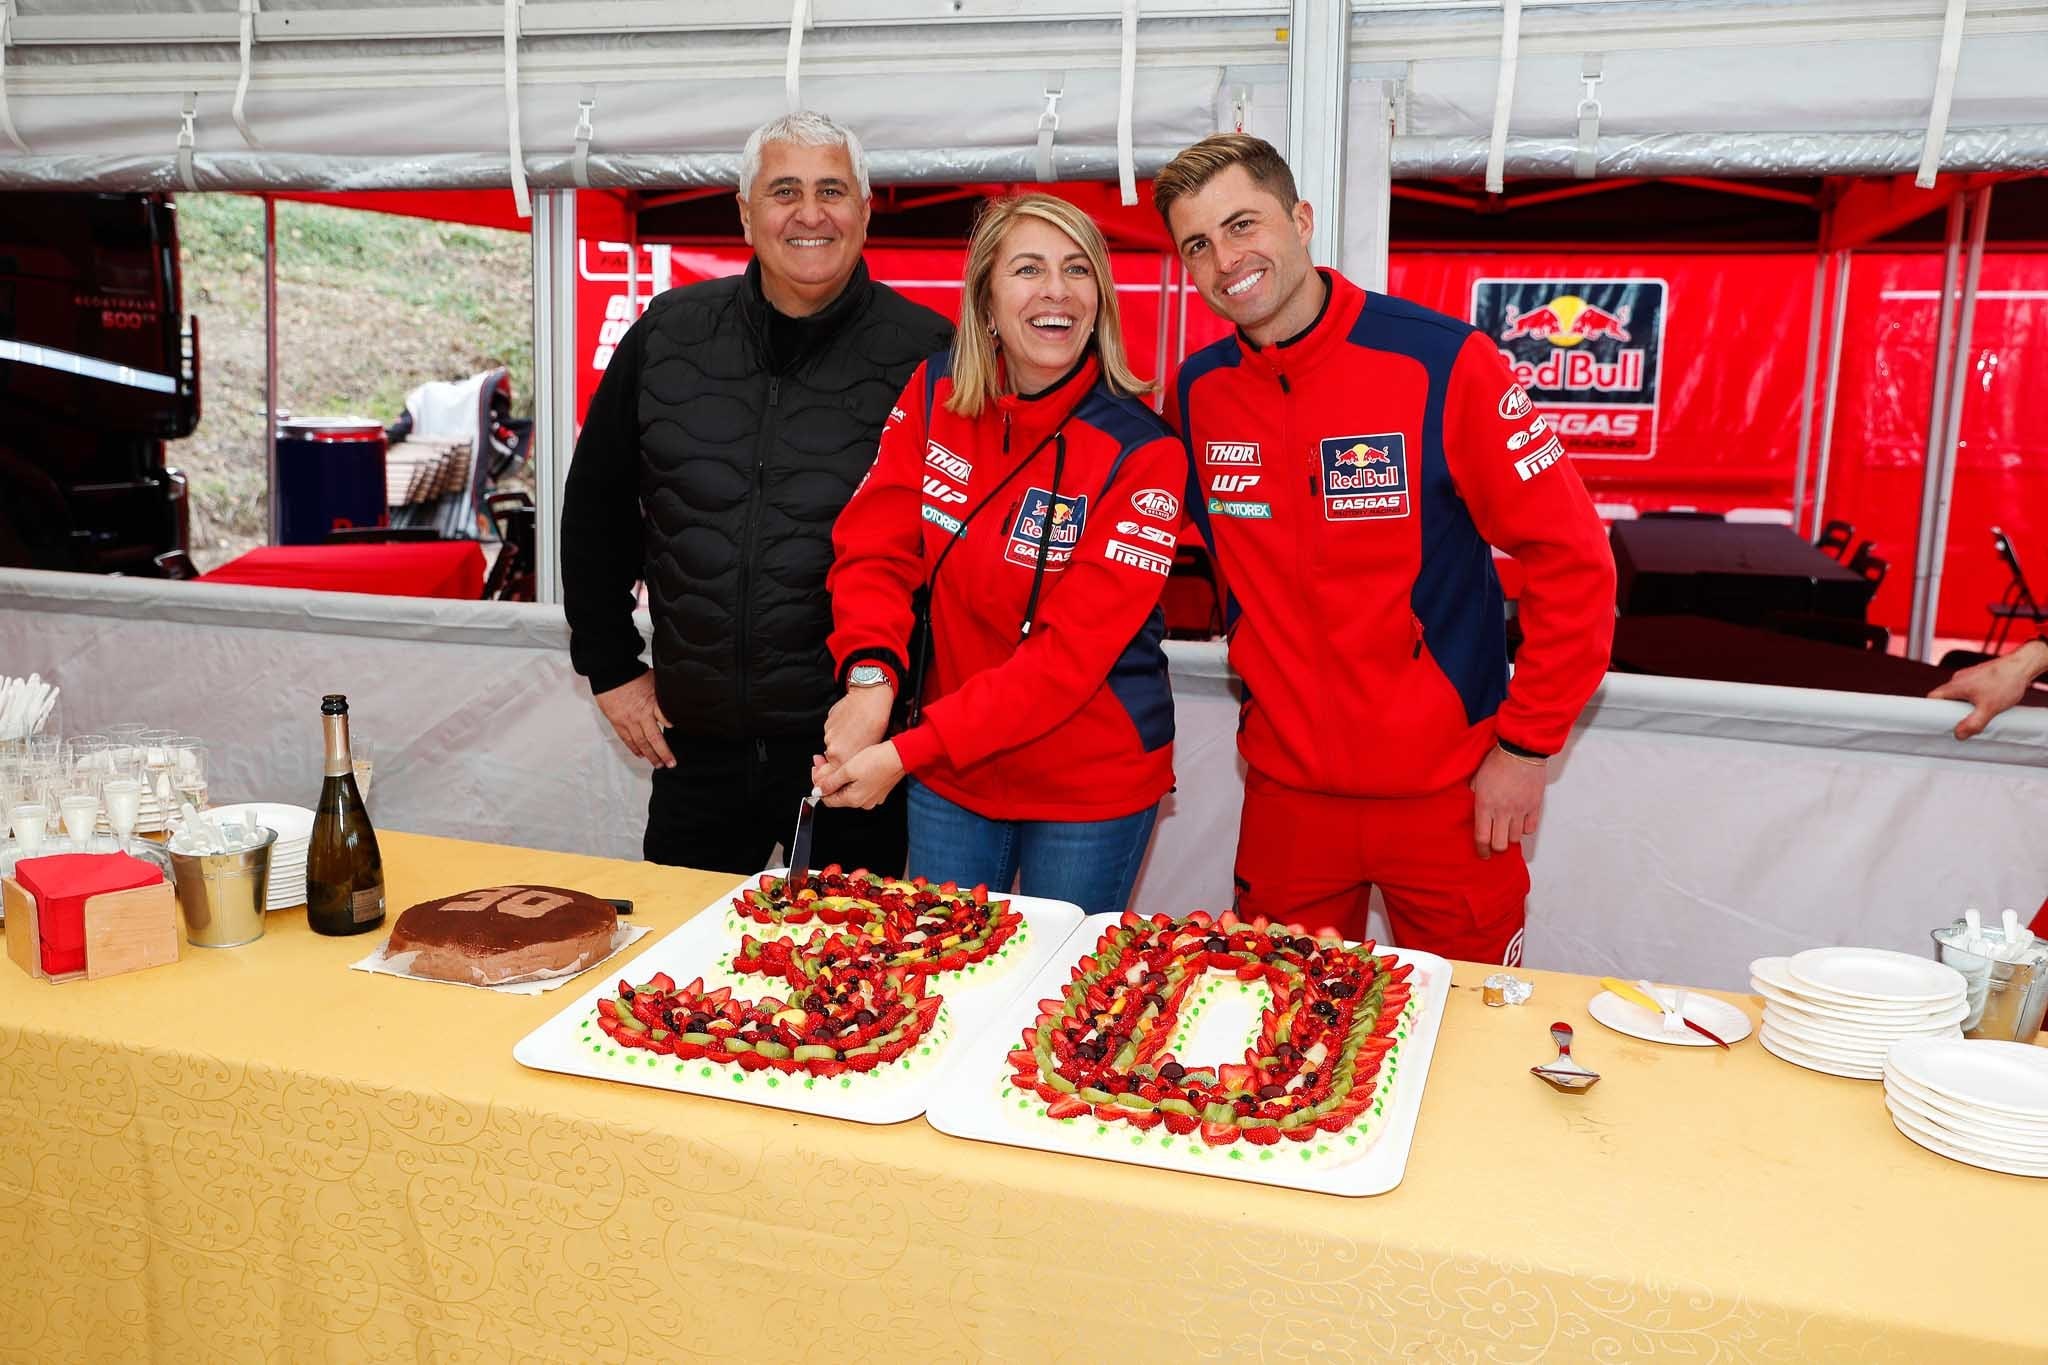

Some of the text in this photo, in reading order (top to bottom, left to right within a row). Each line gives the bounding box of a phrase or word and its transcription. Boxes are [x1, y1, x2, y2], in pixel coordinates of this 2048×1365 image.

[1564, 349, 1645, 391] Bull
[1210, 445, 1255, 462] THOR
[1211, 474, 1260, 492] WP
[1330, 466, 1399, 490] Red Bull
[1136, 493, 1176, 513] Airoh
[1222, 502, 1270, 518] MOTOREX
[1332, 496, 1400, 510] GASGAS
[1020, 517, 1047, 539] Re
